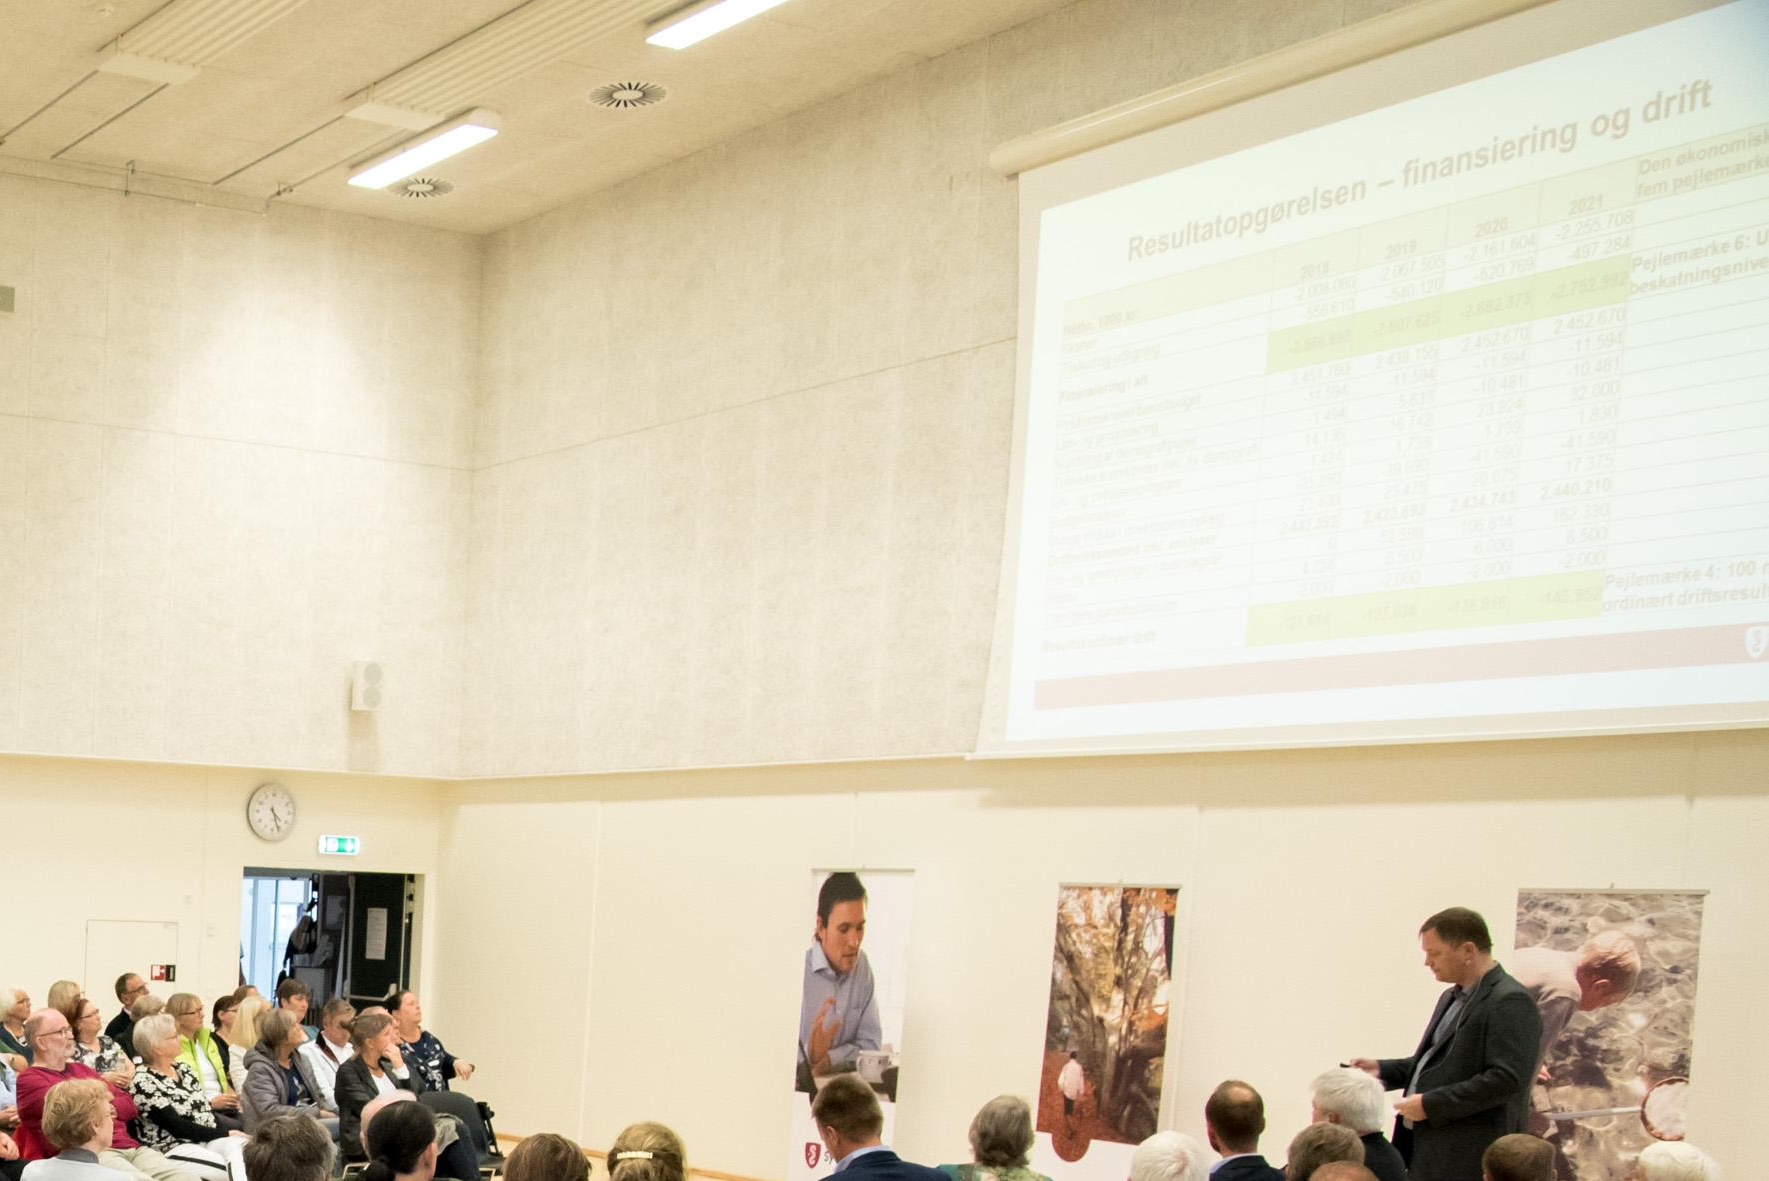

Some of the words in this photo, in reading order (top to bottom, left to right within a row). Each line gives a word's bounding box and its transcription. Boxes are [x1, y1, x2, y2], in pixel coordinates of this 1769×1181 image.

[1128, 179, 1367, 261] Resultatopgørelsen
[1402, 121, 1578, 188] finansiering
[1591, 106, 1631, 139] og
[1642, 78, 1712, 123] drift
[1639, 156, 1671, 176] Den
[1637, 180, 1669, 199] fem
[1063, 321, 1094, 336] Netto,
[1098, 311, 1122, 328] 1000
[1300, 260, 1329, 280] 2018
[1385, 239, 1417, 260] 2019
[1475, 217, 1508, 238] 2020
[1569, 193, 1604, 216] 2021
[1632, 238, 1731, 273] Pejlemærke
[1734, 234, 1751, 250] 6:
[1059, 380, 1126, 402] Finansiering
[1605, 566, 1700, 591] Pejlemærke
[1704, 562, 1721, 580] 4:
[1727, 560, 1756, 577] 100
[1602, 592, 1673, 612] ordinært
